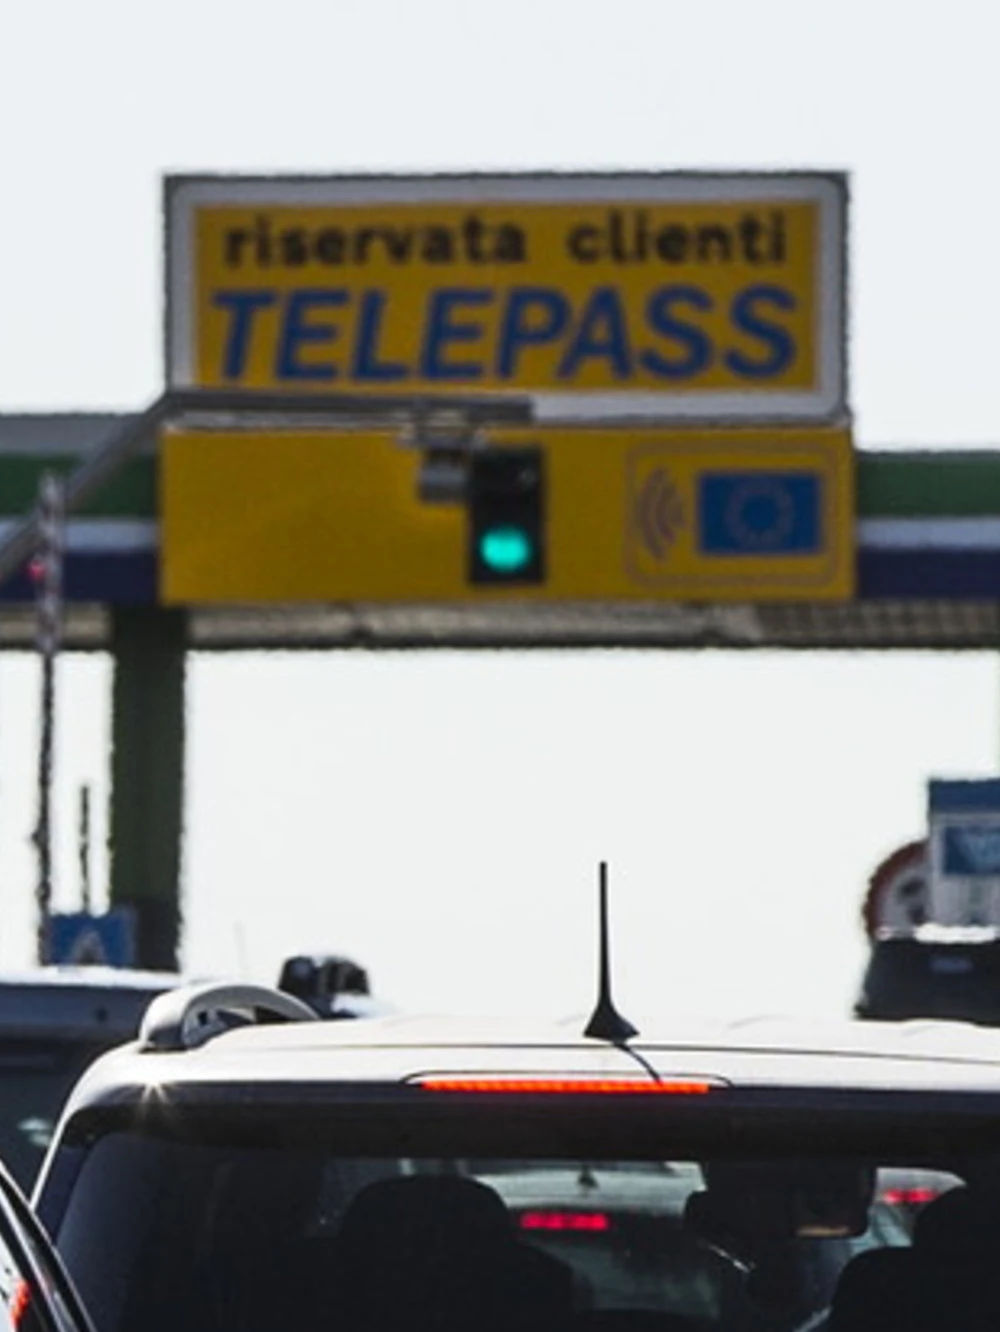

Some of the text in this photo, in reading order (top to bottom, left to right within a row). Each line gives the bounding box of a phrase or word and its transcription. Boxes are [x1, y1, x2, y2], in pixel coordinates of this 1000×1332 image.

[223, 210, 788, 268] riservata clienti
[209, 284, 797, 382] TELEPASS
